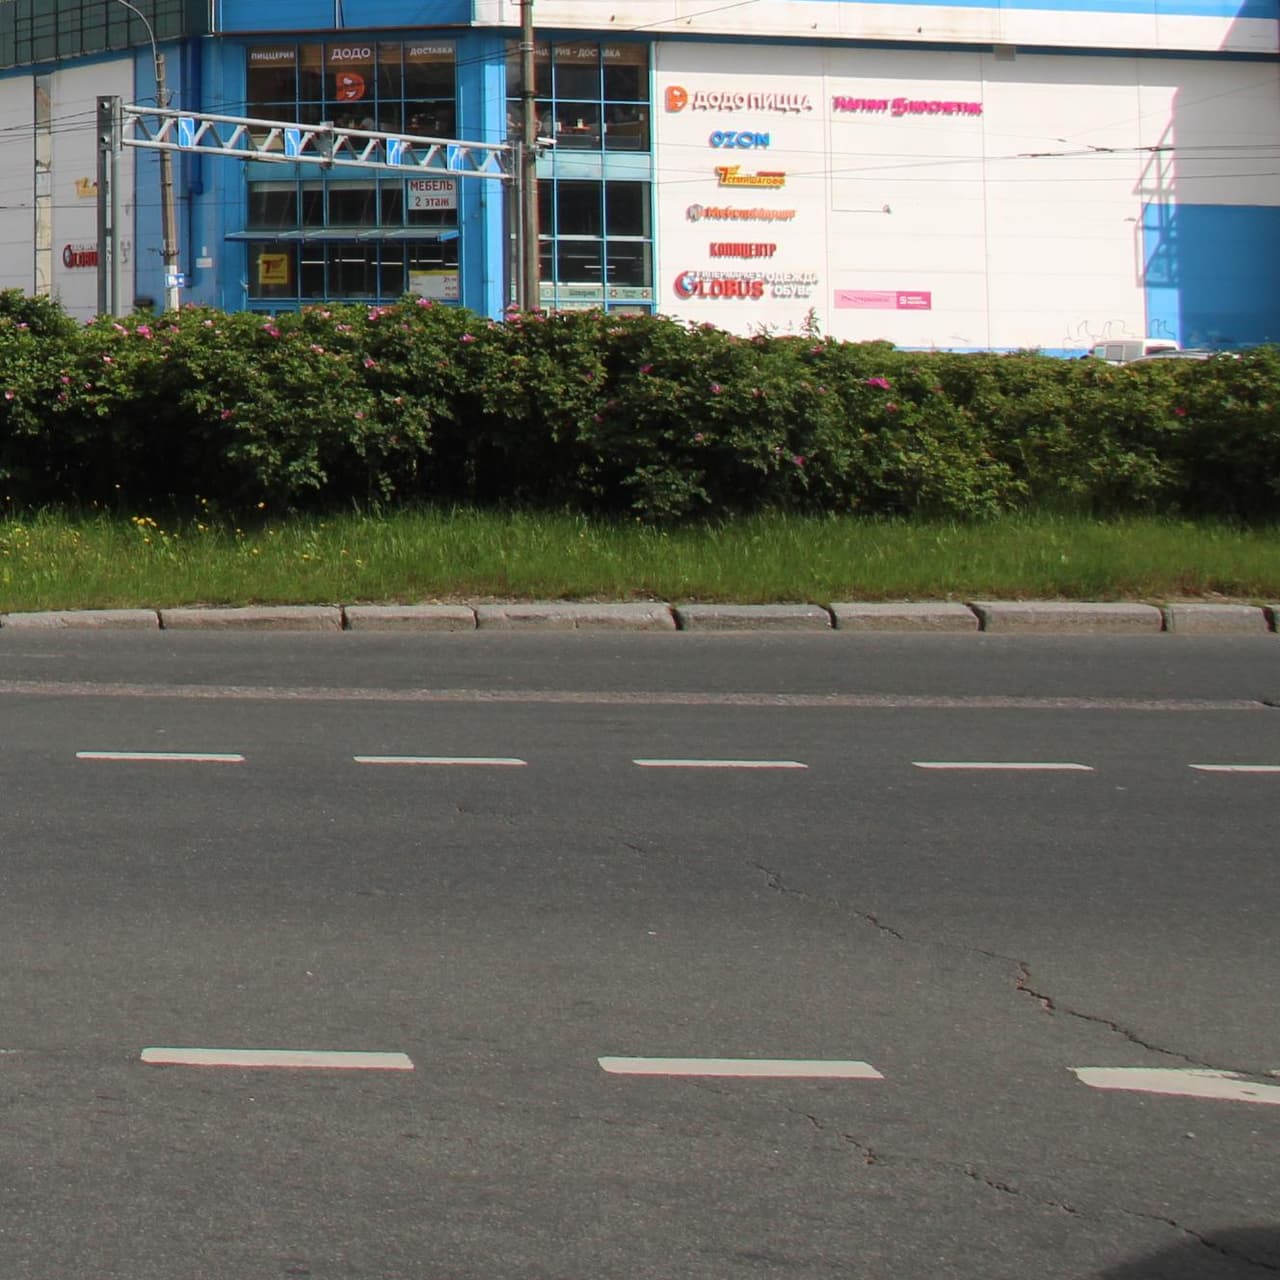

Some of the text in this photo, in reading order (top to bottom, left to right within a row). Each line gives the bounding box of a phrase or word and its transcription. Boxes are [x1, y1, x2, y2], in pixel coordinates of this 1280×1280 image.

[331, 47, 372, 61] ДОДО
[410, 46, 454, 56] ДОСТАВКА
[692, 91, 813, 114] ДОДО ПИЦЦА
[709, 130, 770, 149] OZON
[410, 180, 453, 191] МЕБЕЛЬ
[415, 196, 450, 207] 2 этаж
